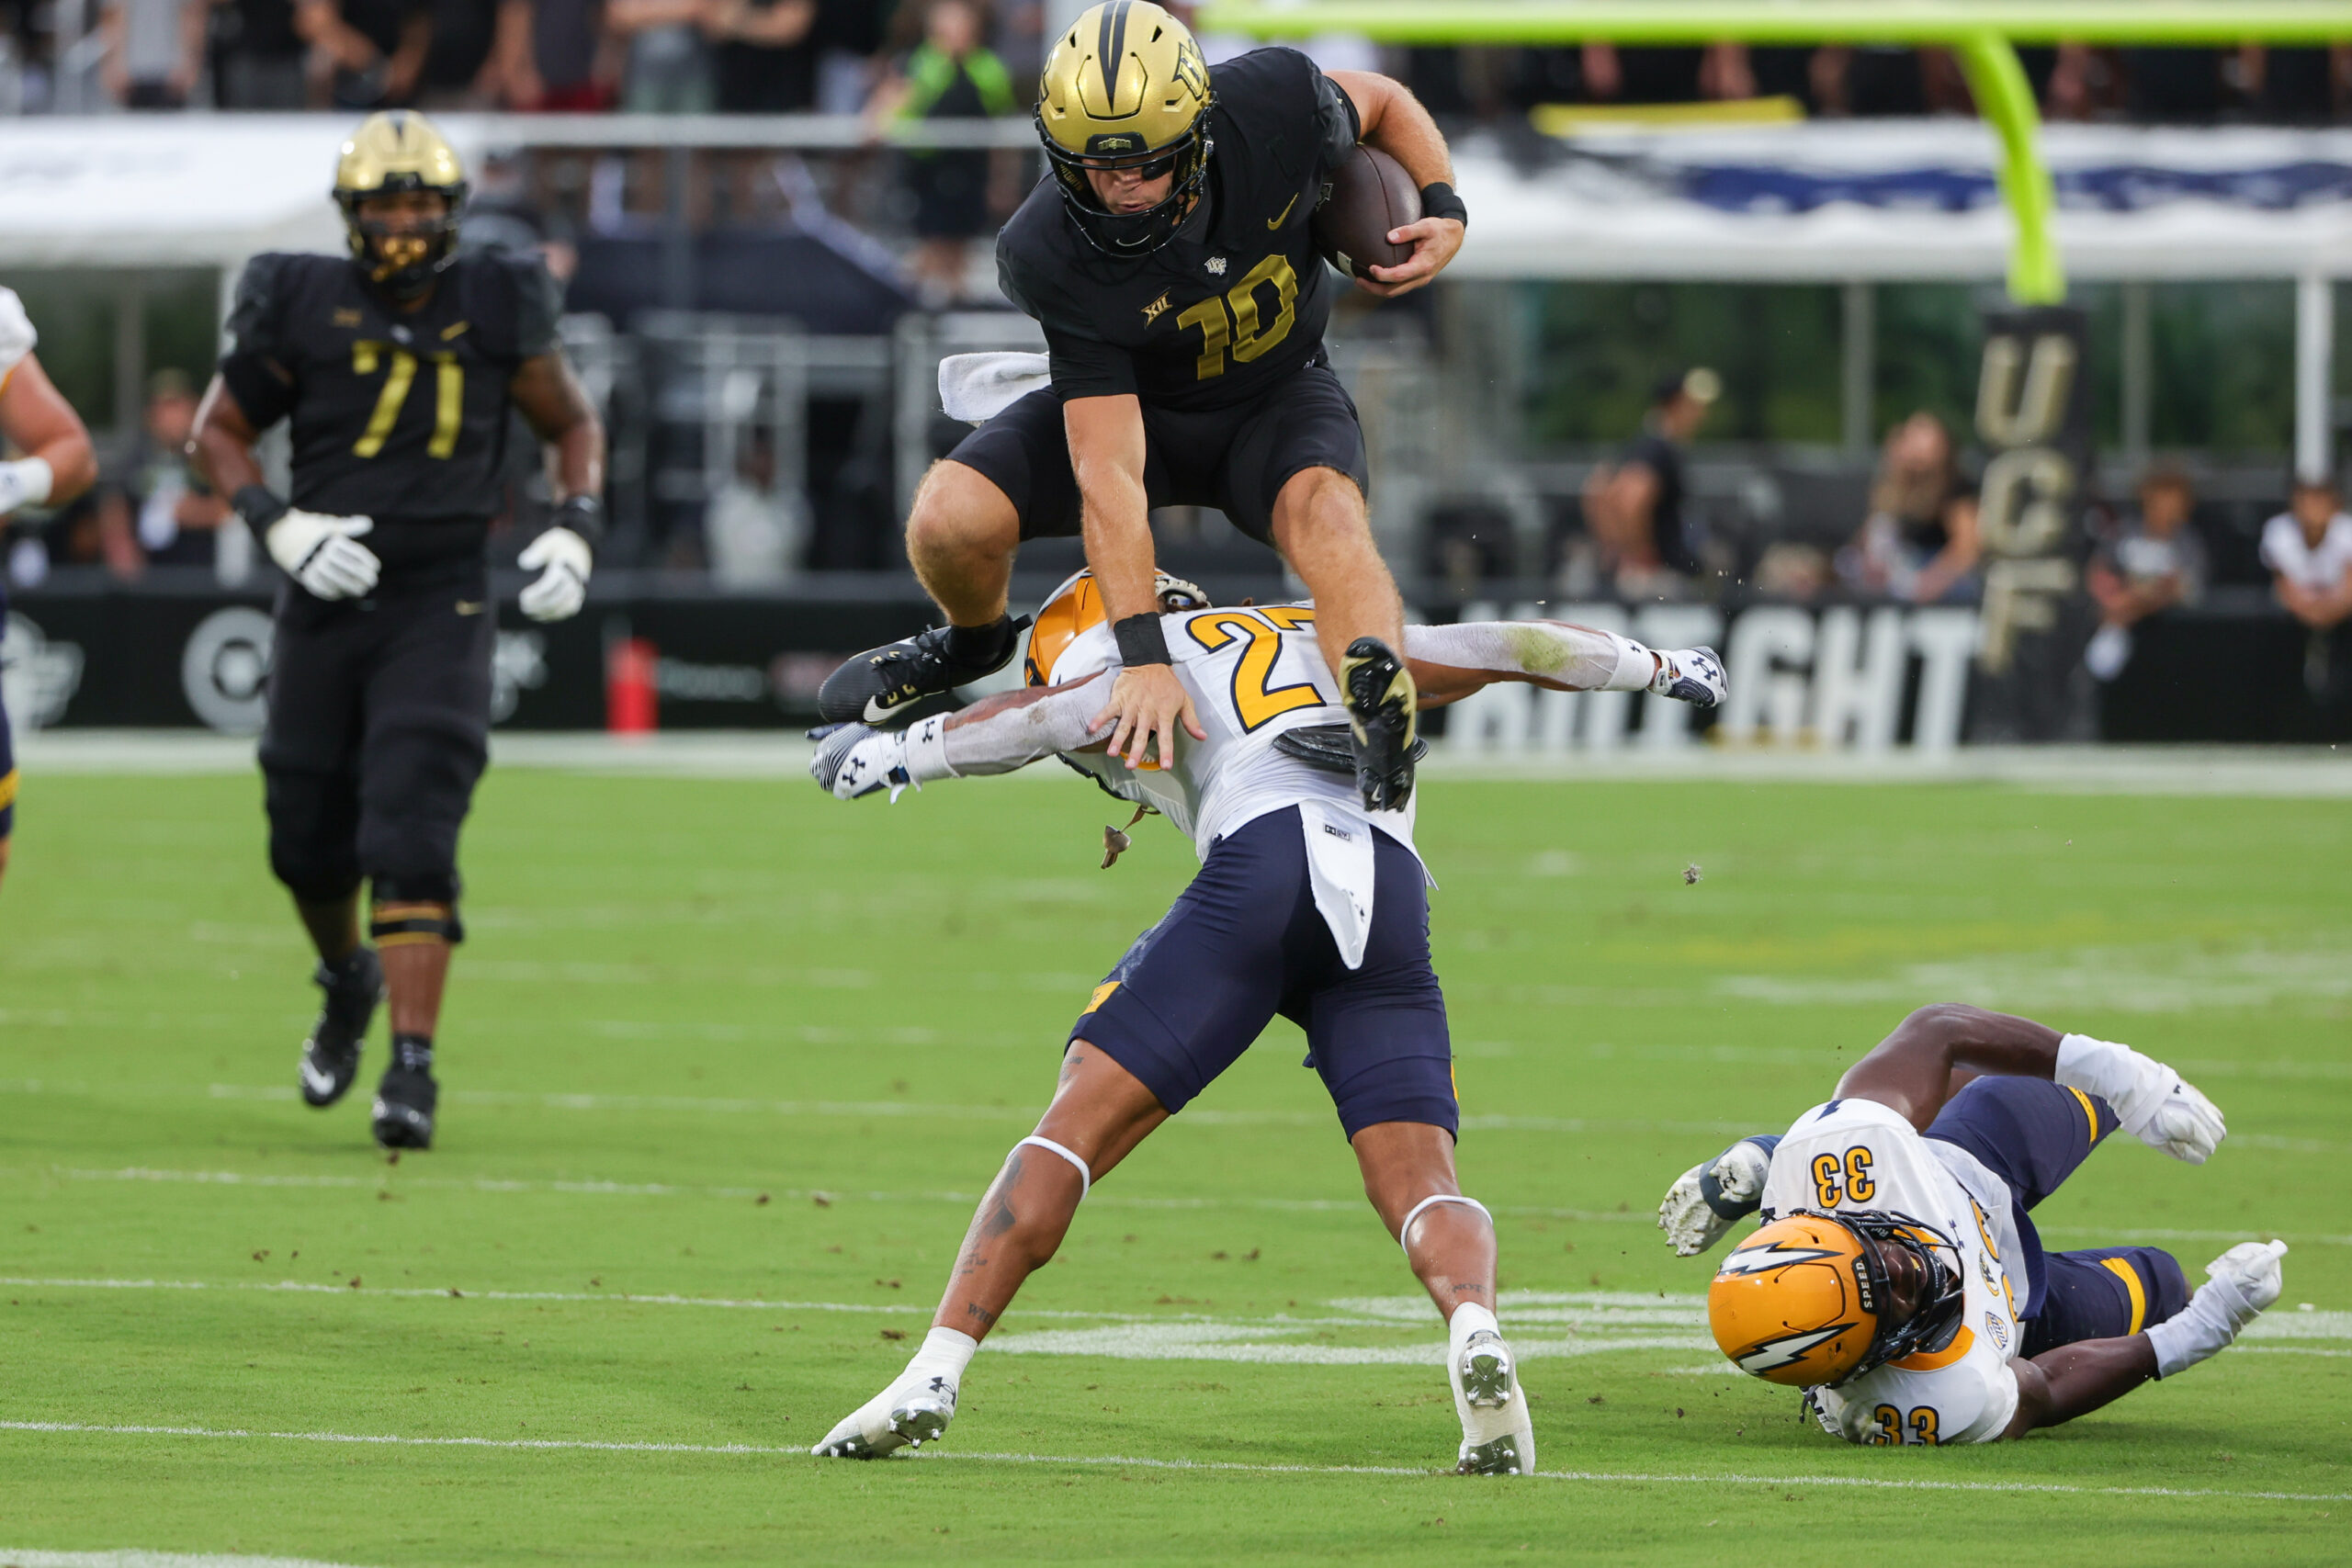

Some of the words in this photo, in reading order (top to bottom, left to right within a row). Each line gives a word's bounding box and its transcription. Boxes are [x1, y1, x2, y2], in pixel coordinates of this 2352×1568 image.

[1204, 257, 1227, 276] UCF
[1176, 254, 1299, 380] 10
[351, 340, 464, 459] 71
[1974, 333, 2078, 676] UCF
[1185, 606, 1327, 735] 2
[1811, 1145, 1876, 1209] 33
[1855, 1259, 1873, 1309] SPEED
[1873, 1403, 1939, 1448] 33
